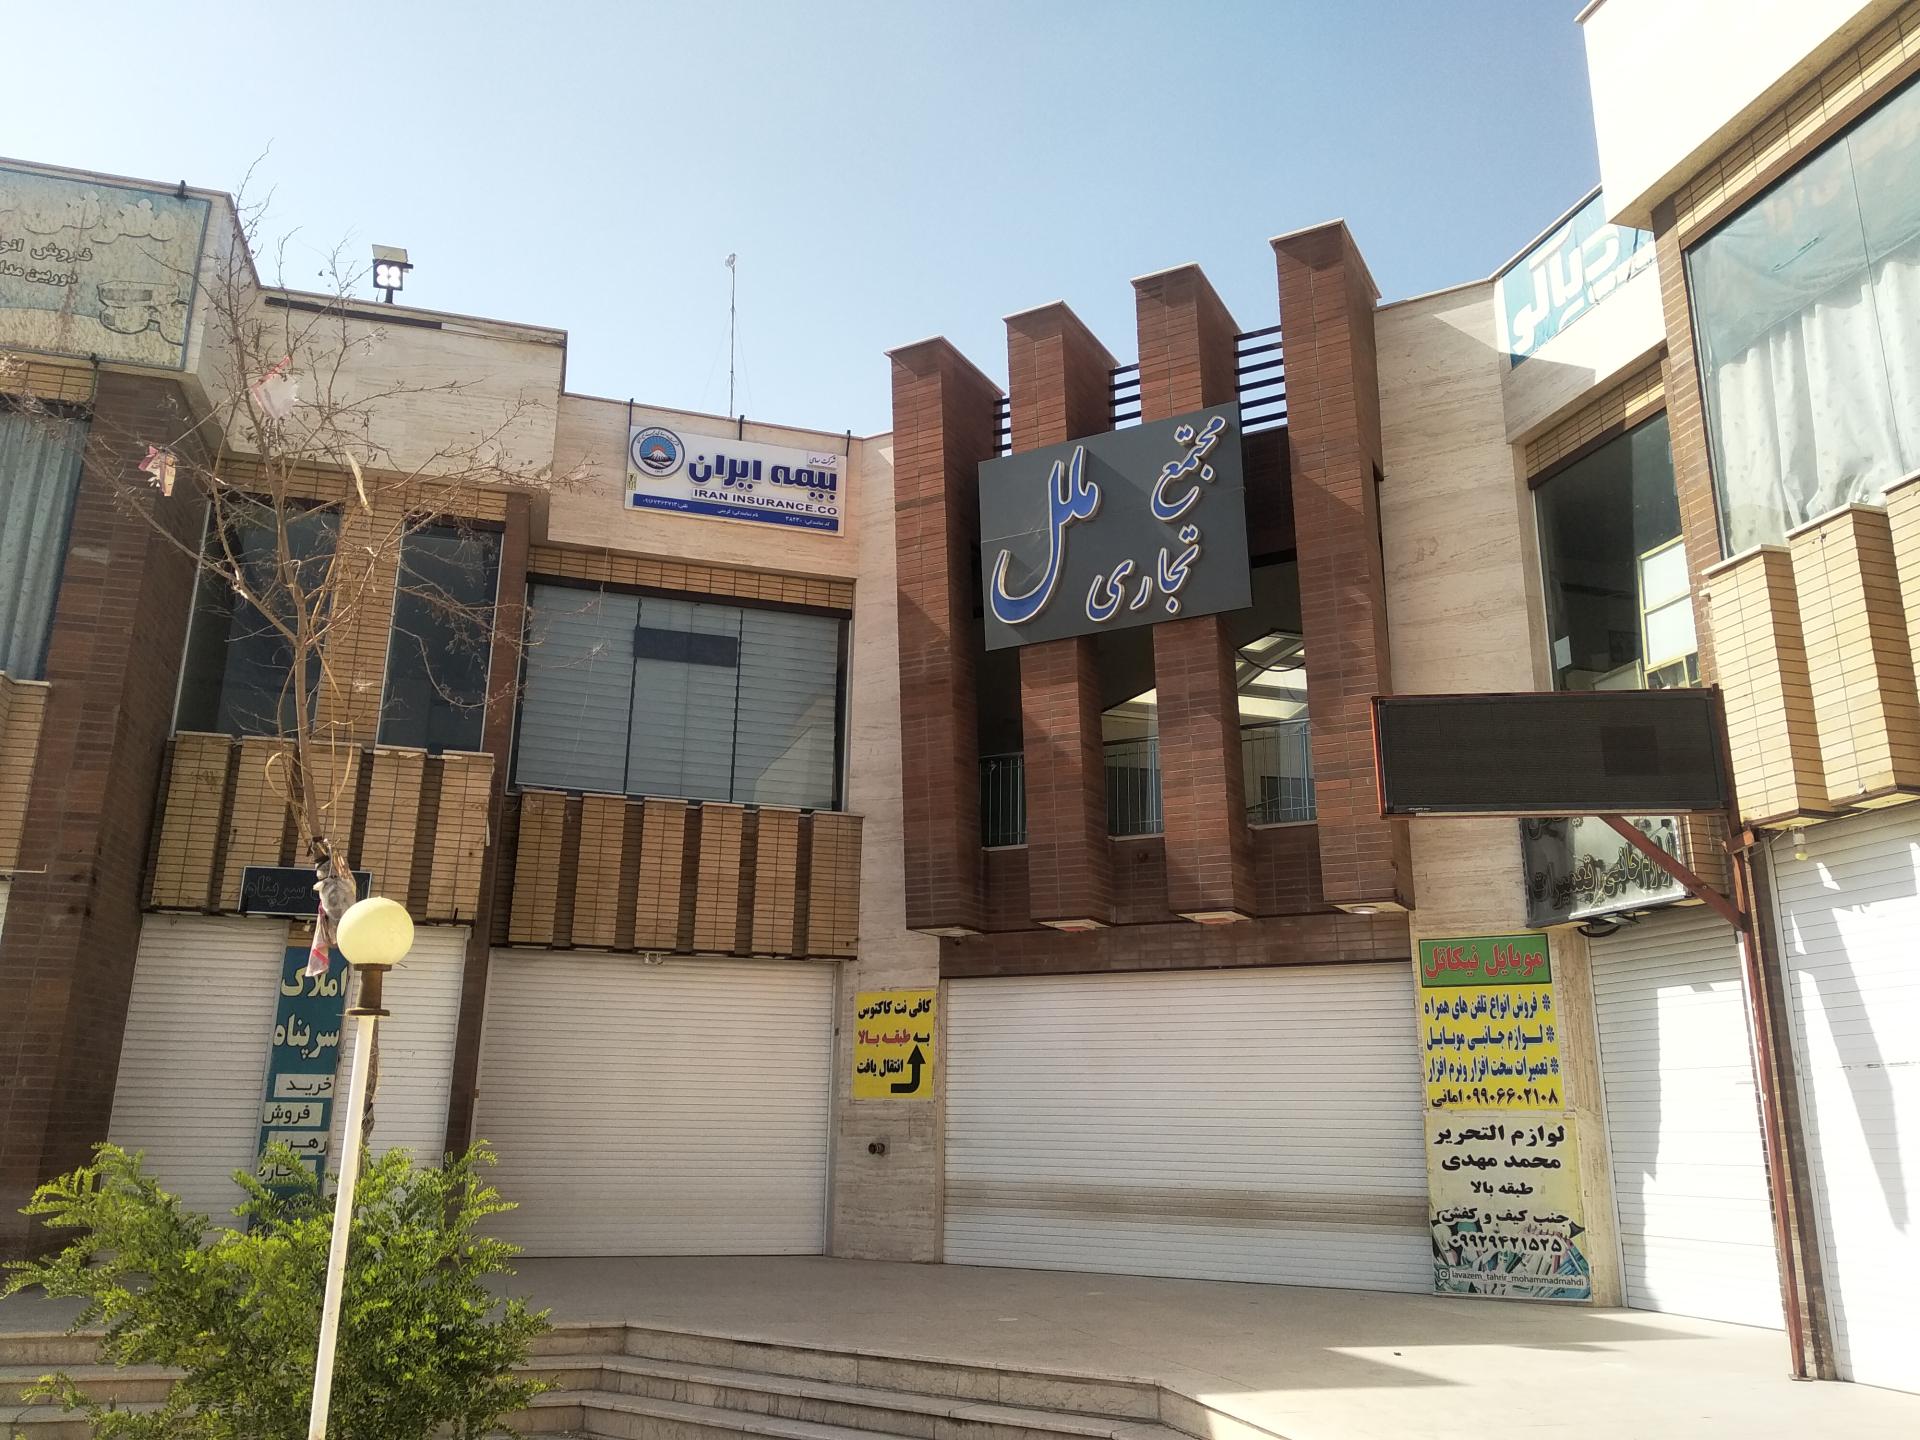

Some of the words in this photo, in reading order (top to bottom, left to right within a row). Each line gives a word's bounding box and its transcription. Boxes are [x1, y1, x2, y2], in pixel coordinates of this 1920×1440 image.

[30, 242, 93, 263] فروش
[25, 269, 78, 287] دوربین
[688, 454, 762, 491] ایران
[1151, 416, 1227, 521] مجتمع
[770, 465, 838, 501] بیمه
[693, 489, 728, 501] IRAN
[732, 492, 838, 516] INSURANCE.CO
[990, 445, 1099, 623] ملل
[1086, 523, 1200, 622] تجاری
[1485, 943, 1544, 976] موبایل
[858, 1000, 893, 1019] کاکتوس
[894, 1000, 907, 1014] نت
[909, 998, 932, 1018] کافی
[1452, 996, 1468, 1020] های
[1470, 994, 1487, 1019] تلفن
[1490, 994, 1510, 1019] انواع
[1513, 992, 1538, 1019] فروش
[273, 1013, 340, 1059] سرپناه
[858, 1030, 880, 1047] بالا
[882, 1029, 911, 1047] طبقه
[913, 1032, 930, 1046] به
[1426, 1026, 1465, 1051] موبایل
[1468, 1025, 1505, 1050] جانبی
[1508, 1024, 1543, 1050] لوازم
[857, 1059, 877, 1077] یافت
[879, 1058, 904, 1077] انتقال
[1428, 1056, 1447, 1083] افزار
[1470, 1056, 1489, 1082] افزار
[1491, 1056, 1513, 1077] سخت
[1515, 1055, 1548, 1082] تعمیرات
[286, 1077, 332, 1095] خرید
[1465, 1087, 1559, 1105] ۰۹۹۰۶۶۰۲۱۰۸
[1431, 1089, 1463, 1108] امانی
[262, 1105, 310, 1124] فروش
[1433, 1124, 1505, 1145] التحریر
[1510, 1125, 1565, 1147] لوازم
[1442, 1154, 1498, 1170] مهدی
[1504, 1155, 1562, 1170] محمد
[1470, 1180, 1494, 1197] بالا
[1498, 1182, 1534, 1198] طبقه
[1438, 1206, 1477, 1223] کفش
[1483, 1213, 1492, 1224] و
[1496, 1209, 1528, 1225] کیف
[1533, 1213, 1569, 1228] جنب
